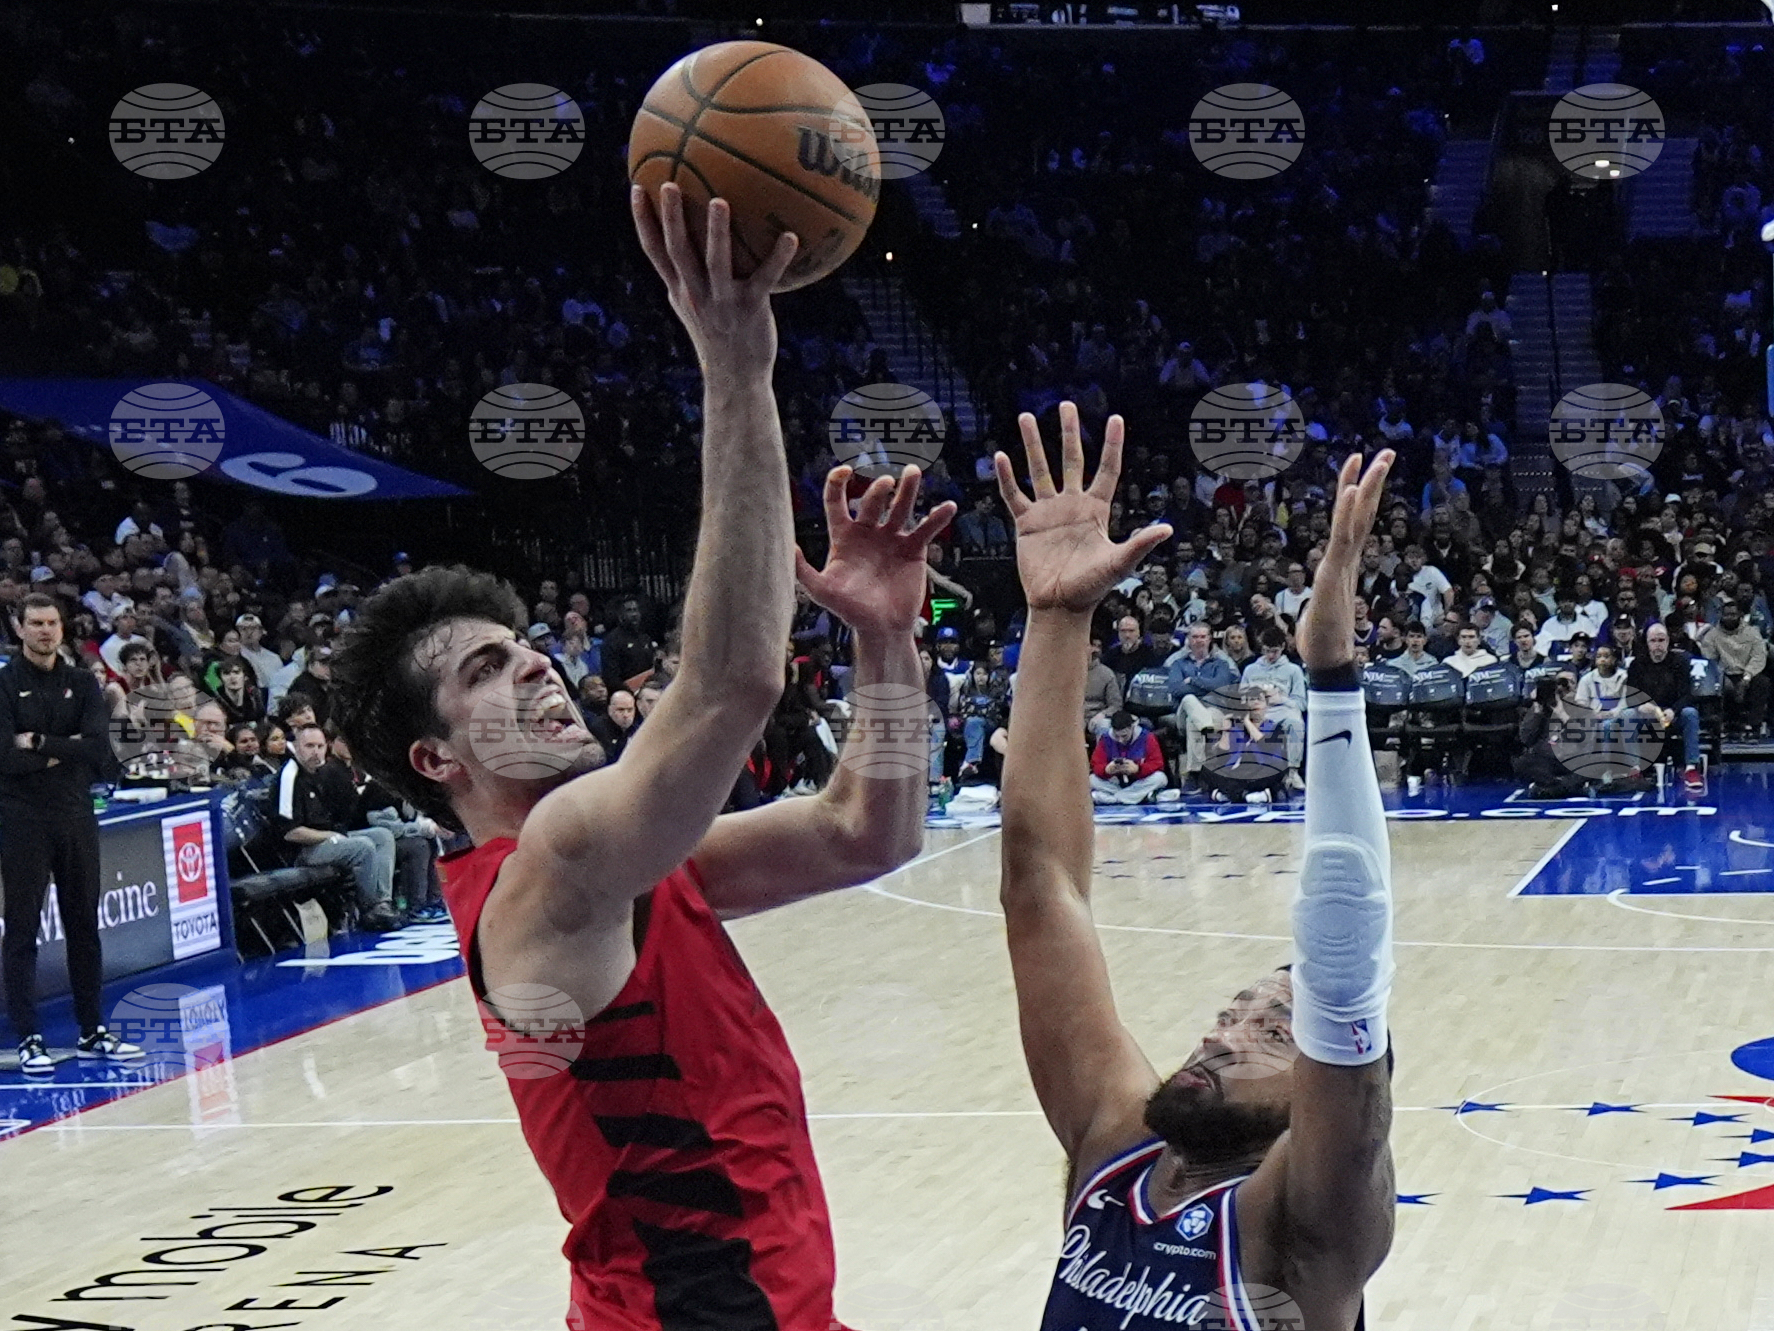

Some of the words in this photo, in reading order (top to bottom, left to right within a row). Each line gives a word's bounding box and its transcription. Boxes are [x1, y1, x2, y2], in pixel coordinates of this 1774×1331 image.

[1094, 806, 1717, 822] crypo.com
[173, 913, 218, 942] TOYOTA
[48, 1185, 395, 1302] mobile
[1153, 1241, 1217, 1260] crypto.com
[1059, 1225, 1211, 1331] Philadelphia
